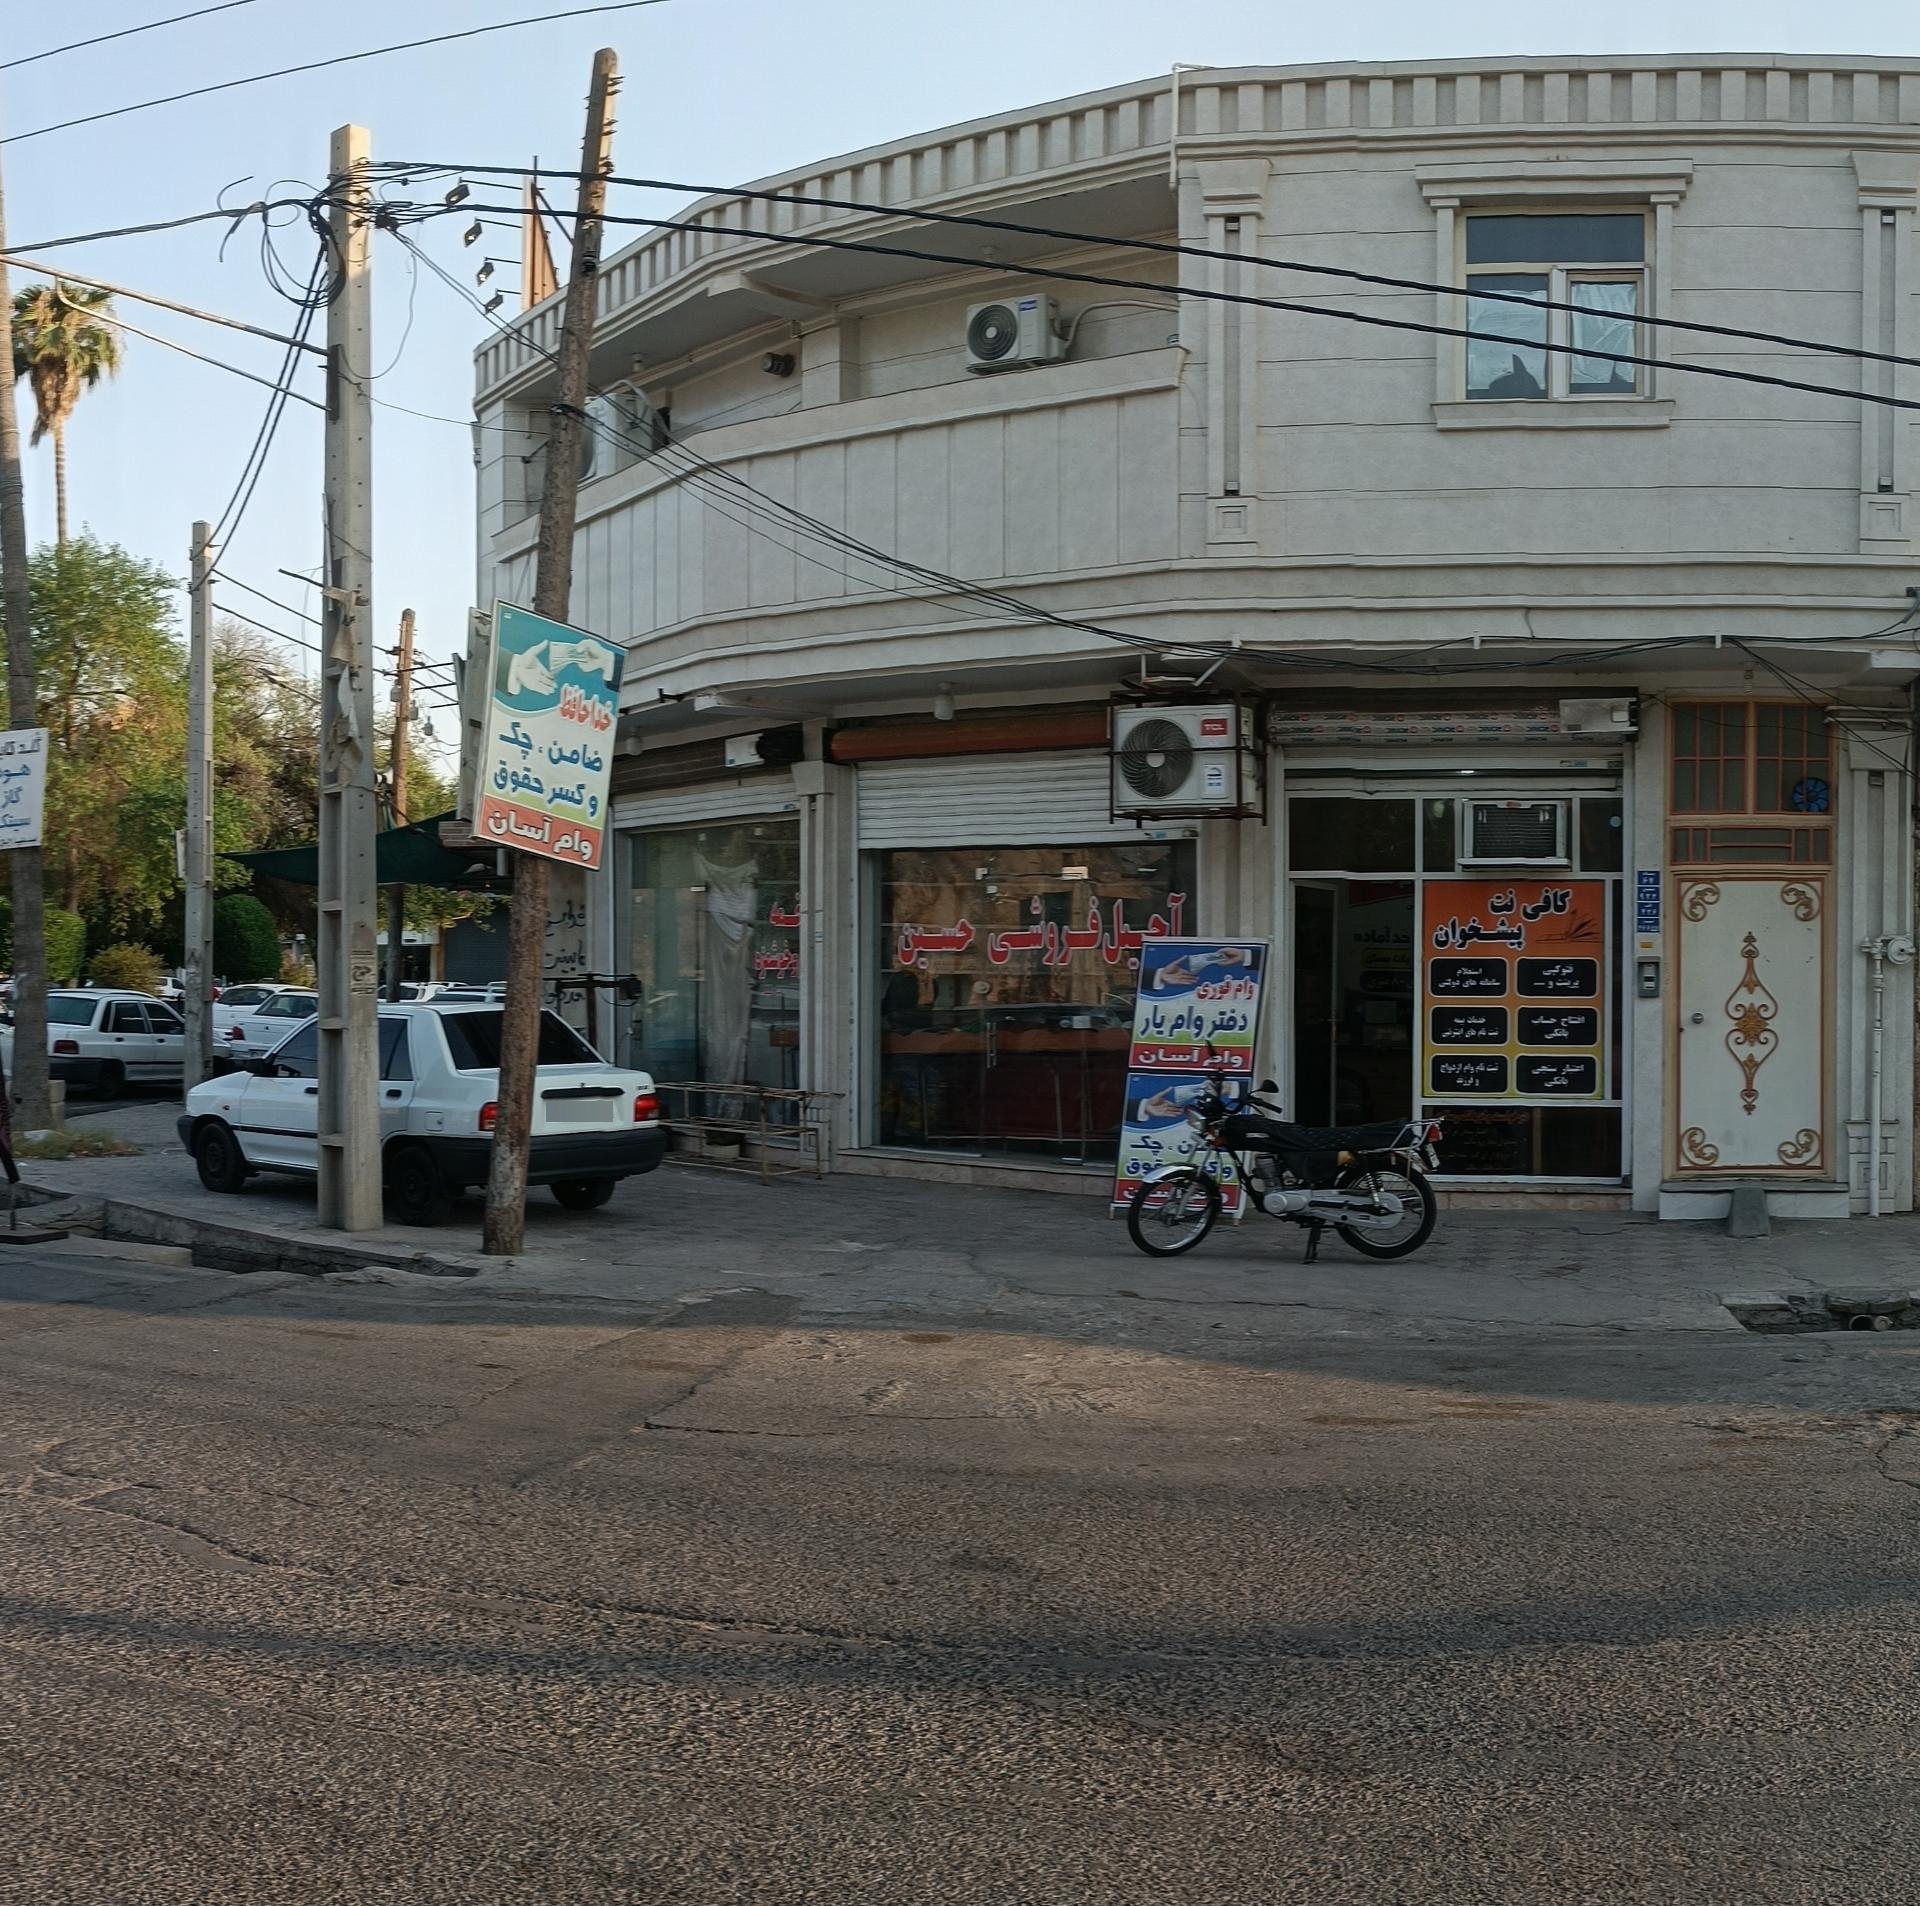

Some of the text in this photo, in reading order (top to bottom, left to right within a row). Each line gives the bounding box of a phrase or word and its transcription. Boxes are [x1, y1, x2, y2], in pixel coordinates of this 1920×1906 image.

[499, 721, 533, 760] چک
[547, 738, 604, 773] ضامن
[493, 760, 544, 794] حقوق
[588, 791, 599, 819] و
[487, 808, 594, 861] وام آسان
[1489, 887, 1571, 921] کافی نت
[897, 918, 976, 970] حسین
[988, 895, 1101, 966] فروشی
[1433, 916, 1524, 950] پیشخوان
[1196, 975, 1255, 1001] وام فوری
[1139, 1003, 1248, 1039] دفتر وام یار
[1138, 1046, 1244, 1068] وام آسان
[1130, 1135, 1163, 1156] چک
